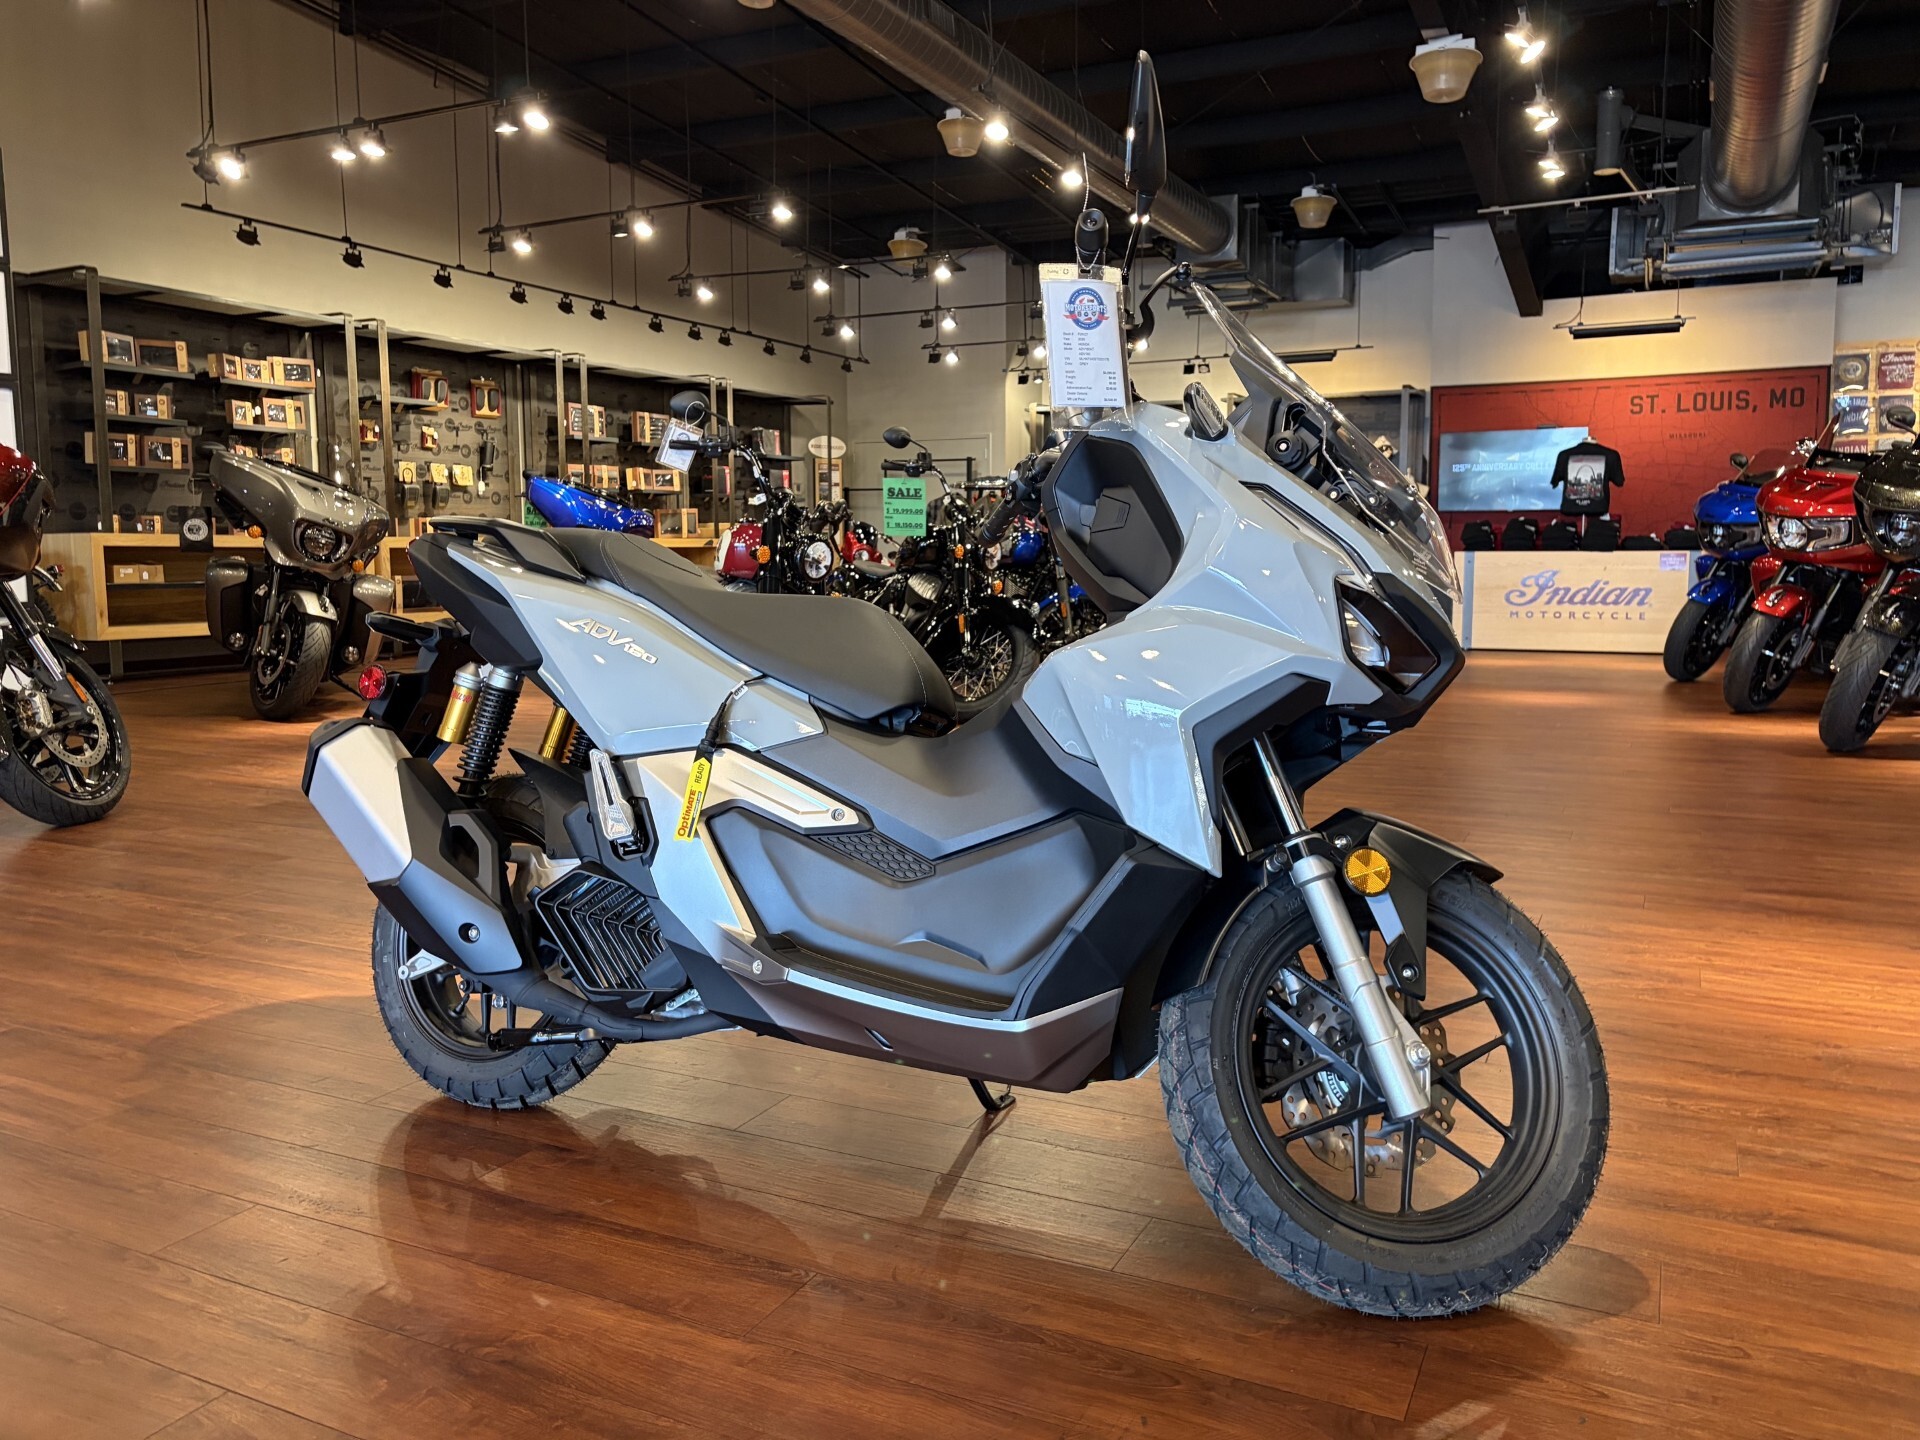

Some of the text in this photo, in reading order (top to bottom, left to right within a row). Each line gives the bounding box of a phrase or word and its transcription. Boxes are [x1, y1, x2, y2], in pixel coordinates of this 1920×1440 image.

[1630, 387, 1805, 415] ST. LOUIS, MO
[1472, 462, 1524, 472] ANNIVERSARY
[1525, 462, 1553, 471] COLLE
[887, 487, 922, 498] SALE
[1504, 569, 1653, 607] Indian
[1509, 611, 1646, 621] MOTORCYCLE
[694, 763, 706, 784] READY
